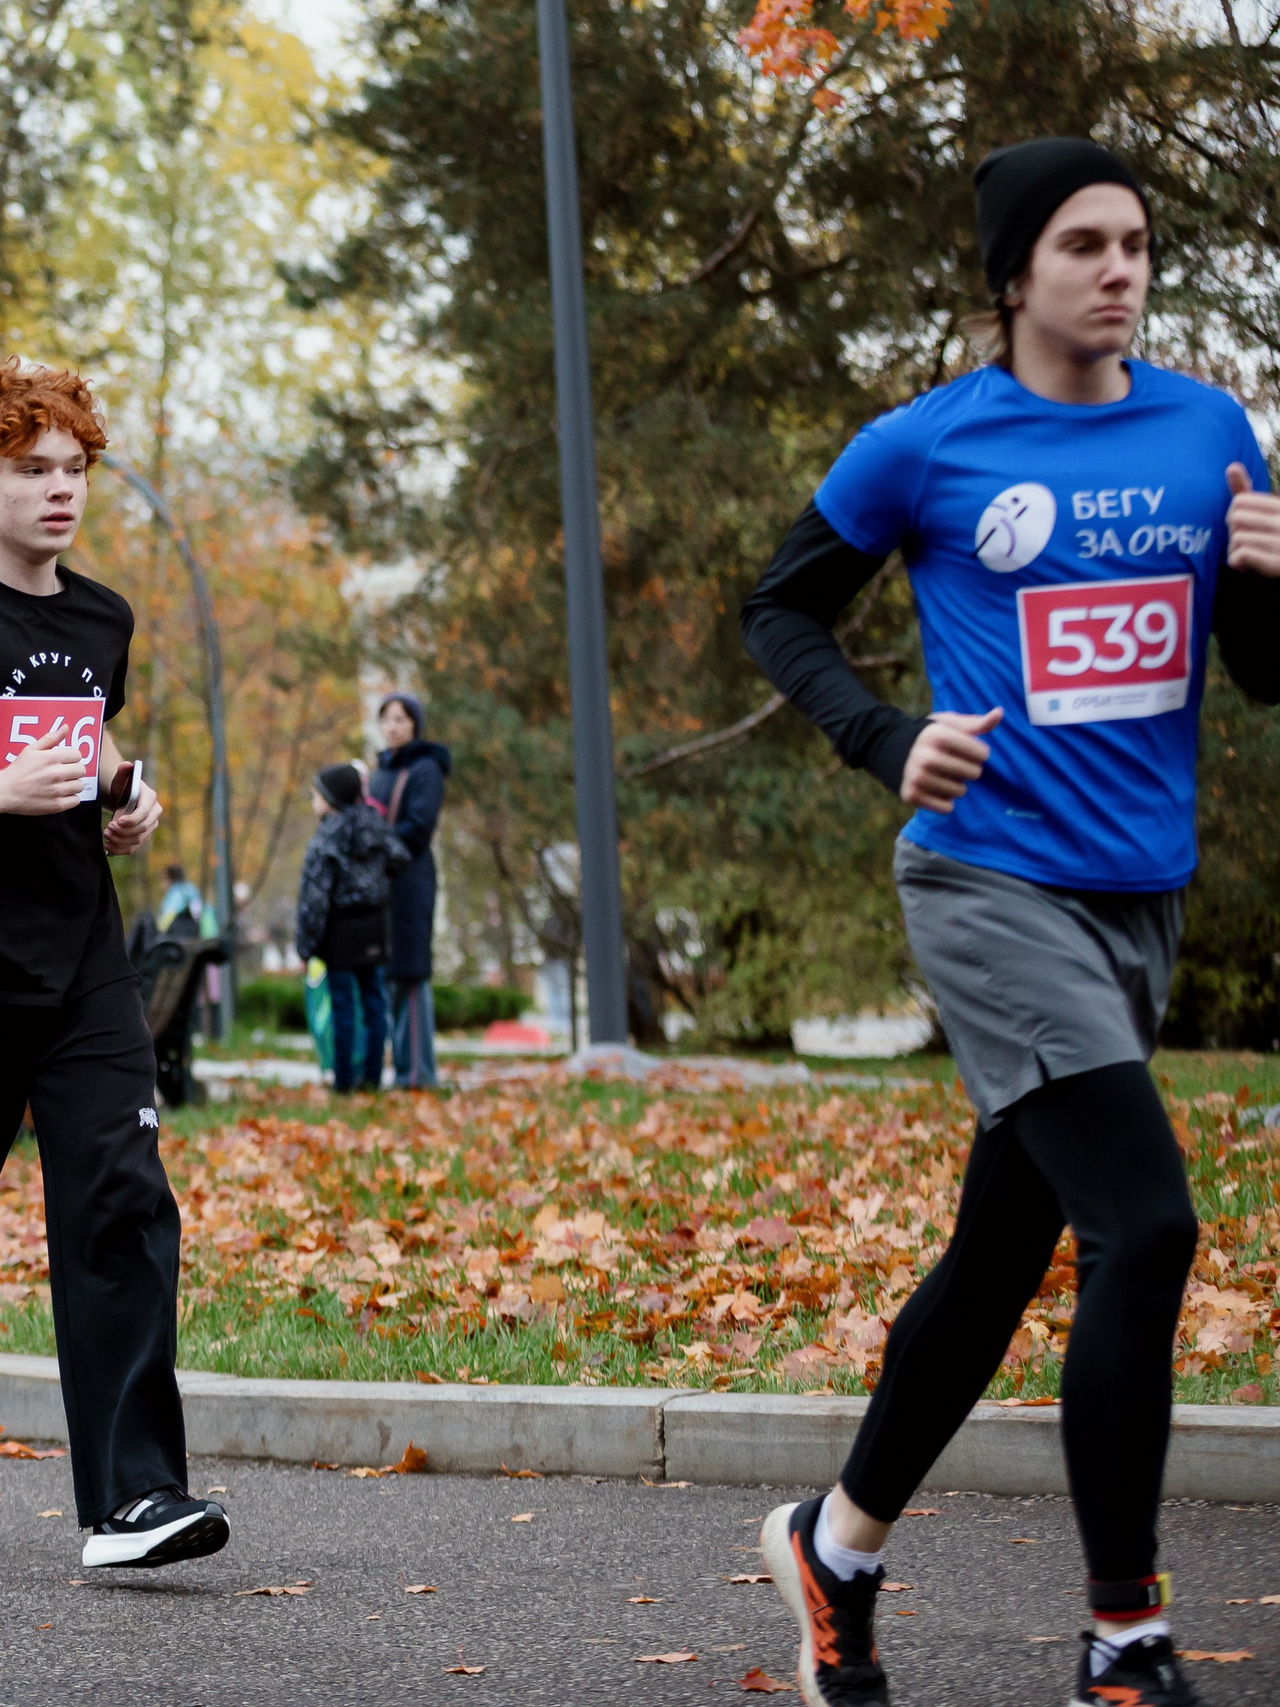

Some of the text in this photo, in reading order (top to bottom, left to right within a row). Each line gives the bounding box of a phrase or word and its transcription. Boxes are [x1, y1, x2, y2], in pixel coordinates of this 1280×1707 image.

[1072, 486, 1165, 520] БЕГУ
[1075, 524, 1211, 559] ЗА ОРБИ
[1046, 600, 1178, 676] 539
[29, 652, 71, 668] КРУГ
